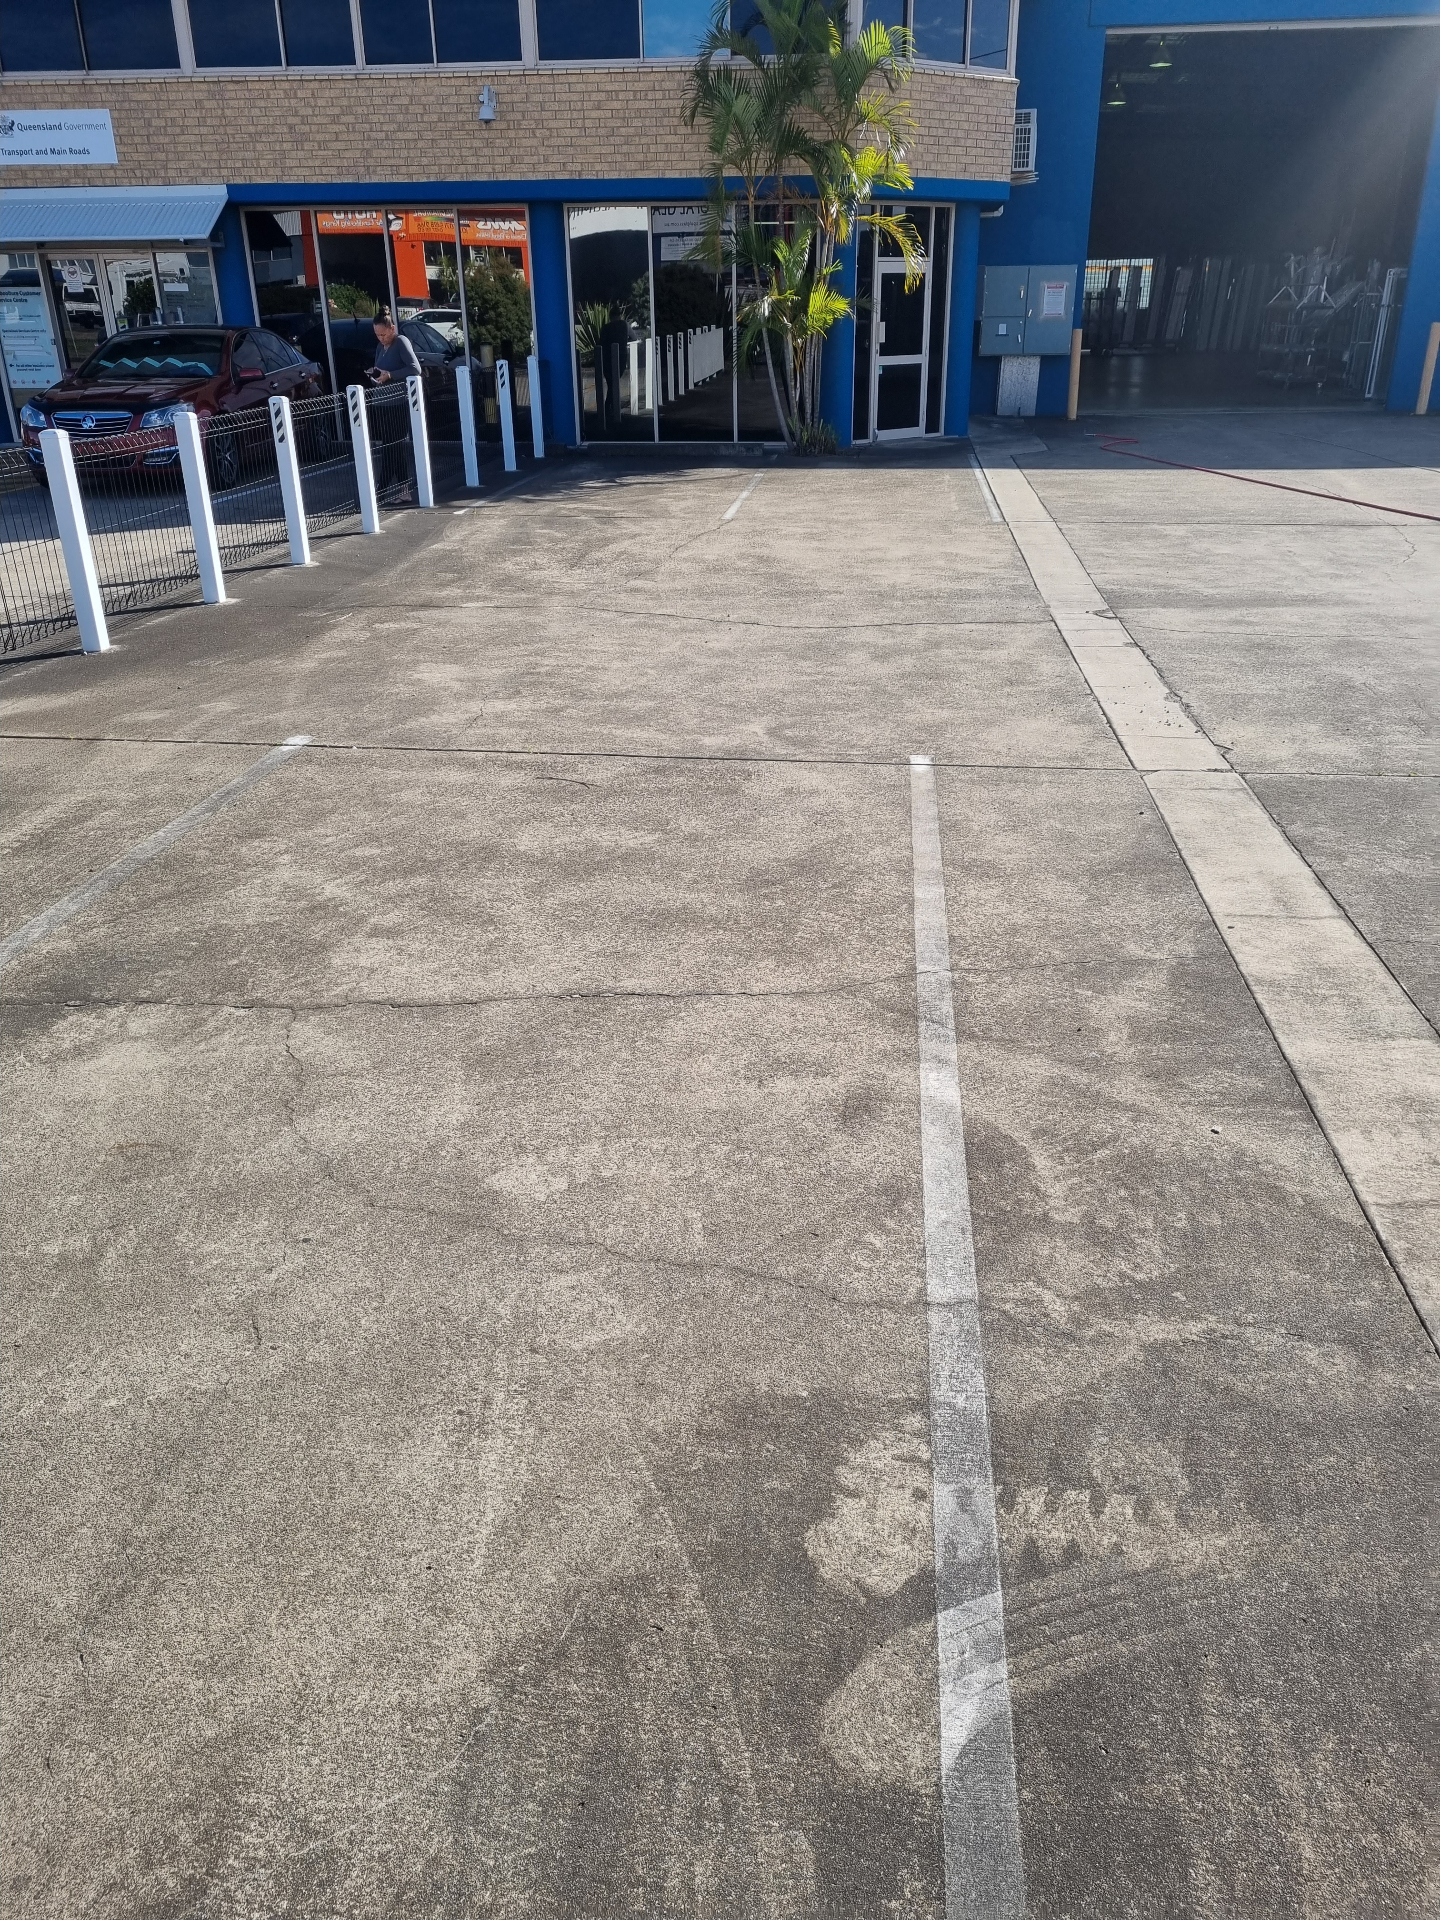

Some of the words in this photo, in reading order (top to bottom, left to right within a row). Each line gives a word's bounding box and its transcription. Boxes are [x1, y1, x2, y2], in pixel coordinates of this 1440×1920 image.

[16, 122, 62, 132] Queensland
[63, 122, 107, 131] Government
[1, 147, 34, 157] Transport
[35, 147, 48, 156] and
[49, 147, 68, 156] Main
[69, 147, 91, 155] Roads
